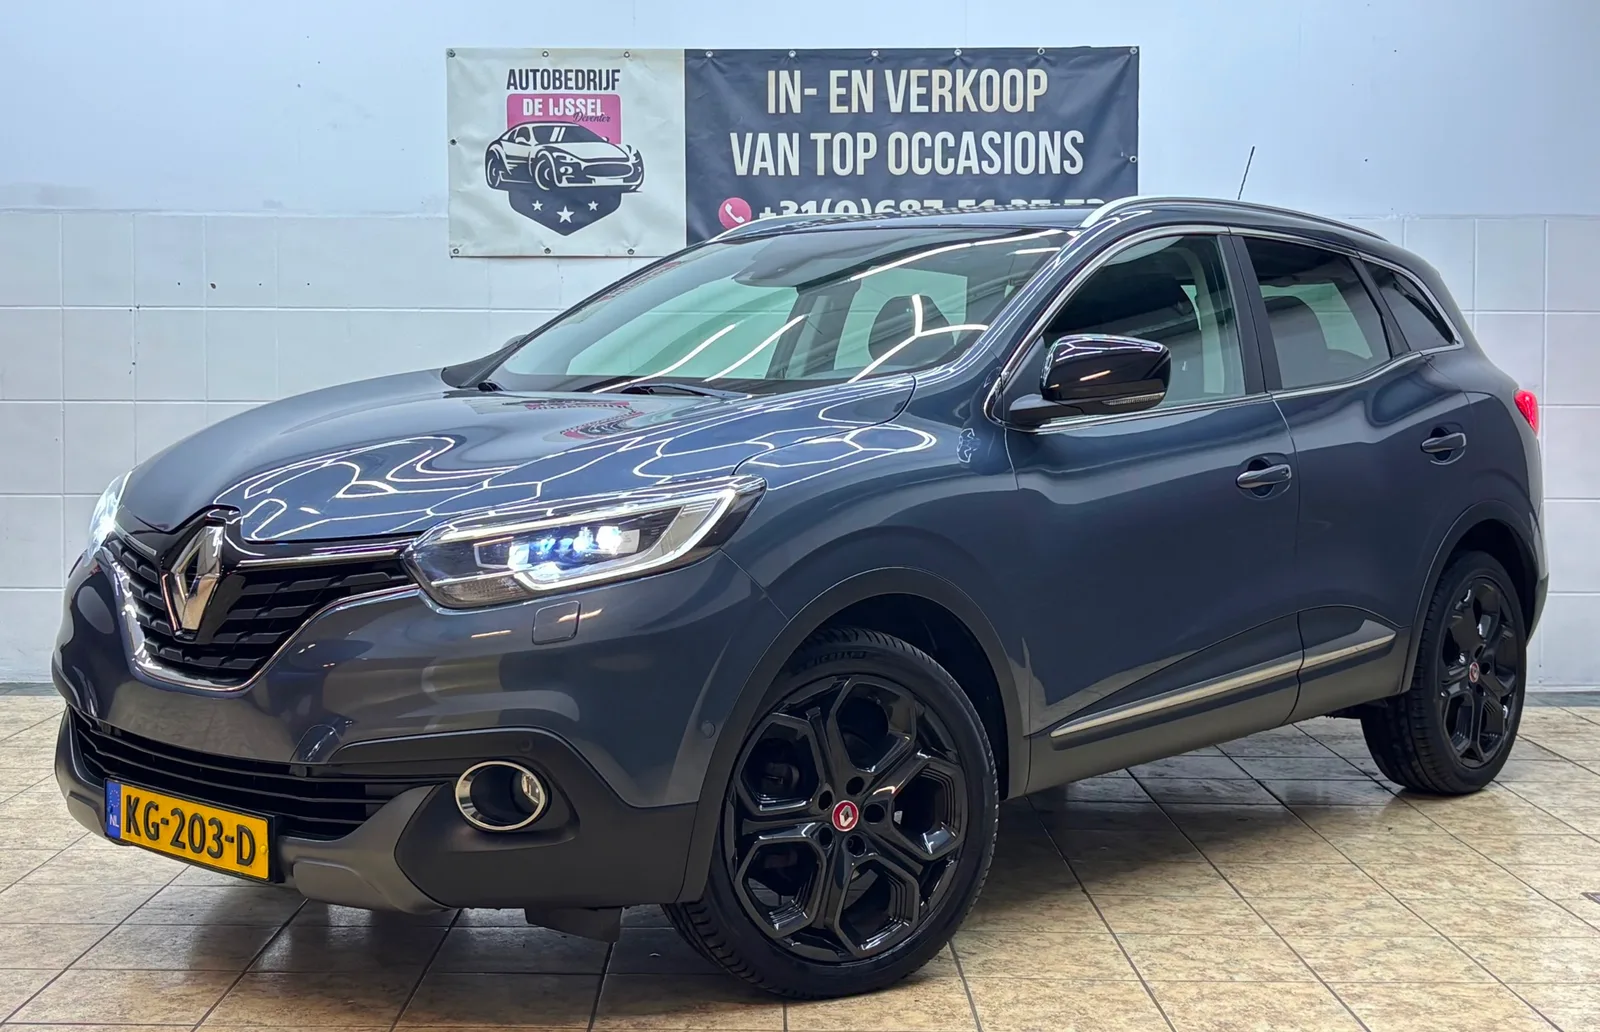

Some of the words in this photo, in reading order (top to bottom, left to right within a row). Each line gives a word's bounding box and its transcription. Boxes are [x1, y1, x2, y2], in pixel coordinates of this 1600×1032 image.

[507, 69, 620, 91] AUTOBEDRIJF
[768, 70, 817, 113] IN-
[830, 70, 873, 113] EN
[885, 69, 1047, 113] VERKOOP
[523, 98, 543, 116] DE
[549, 98, 605, 116] IJSSEL
[573, 111, 610, 123] Deventer
[730, 132, 799, 176] VAN
[810, 132, 877, 175] TOP
[888, 130, 1083, 175] OCCASIONS
[109, 814, 119, 828] NL
[126, 795, 256, 866] KG-203-D
